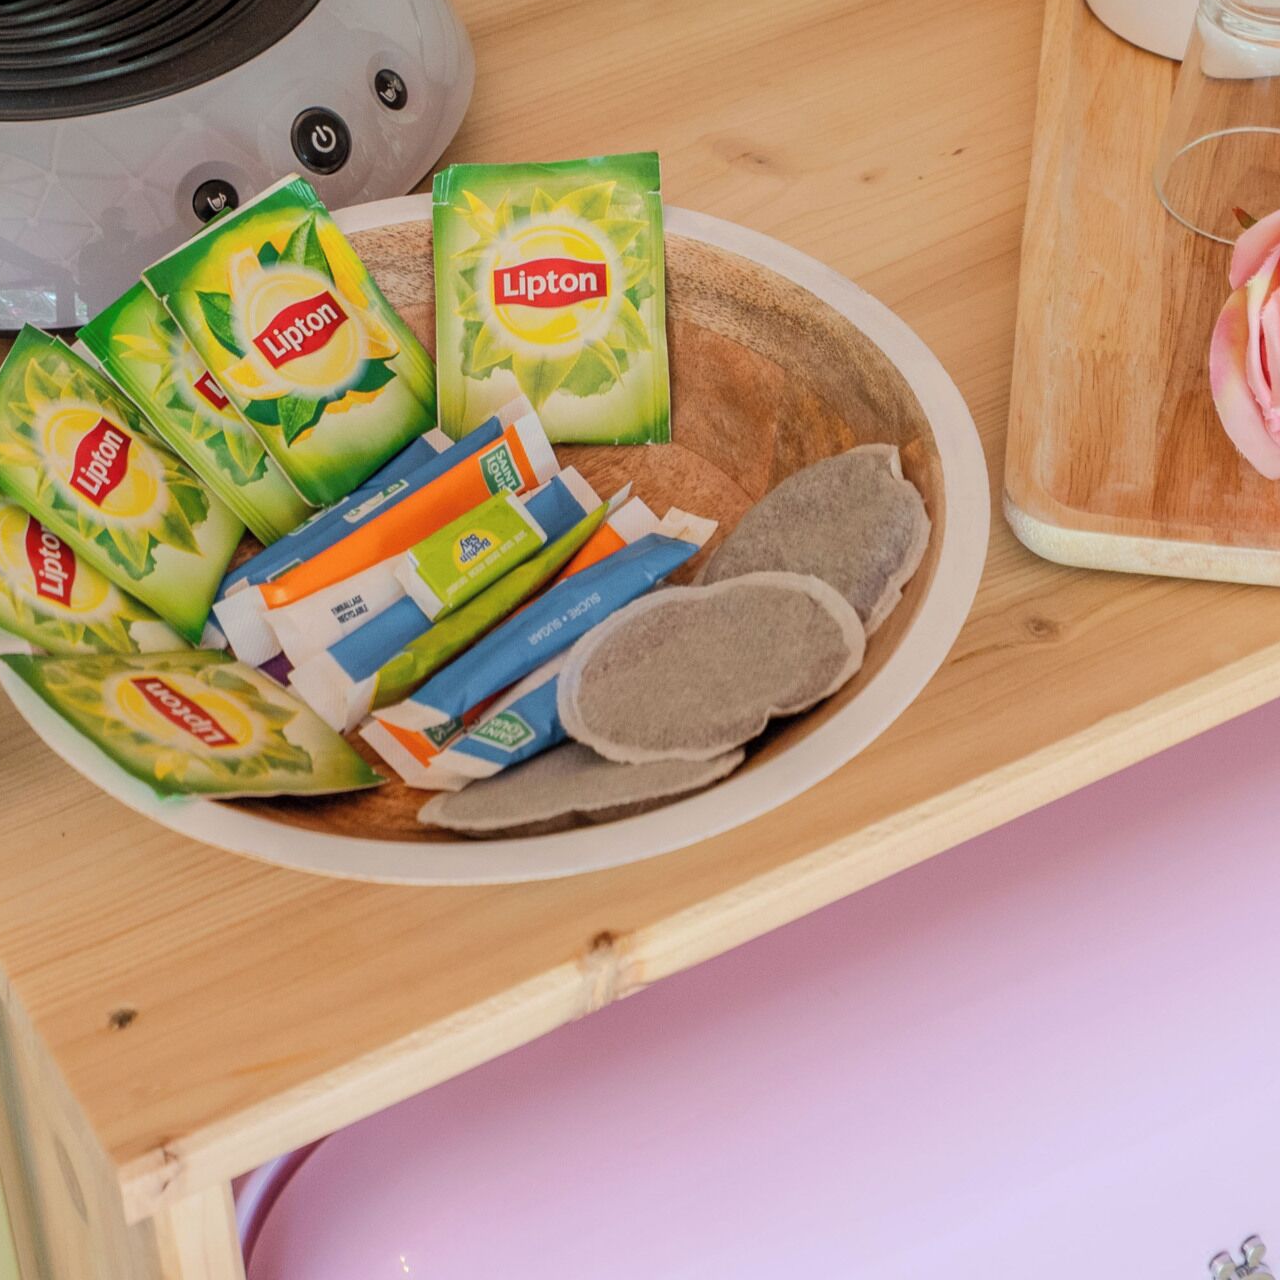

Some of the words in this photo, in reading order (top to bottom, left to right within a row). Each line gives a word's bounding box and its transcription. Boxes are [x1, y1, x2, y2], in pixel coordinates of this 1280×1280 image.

[503, 270, 598, 302] Lipton
[262, 303, 339, 359] Lipton
[77, 429, 124, 496] Lipton
[487, 456, 506, 489] LOUI
[496, 449, 518, 488] SAINT
[39, 523, 67, 598] Lipto
[569, 592, 601, 619] SUCRE
[527, 617, 563, 646] SUGAR
[145, 682, 225, 743] Lipton
